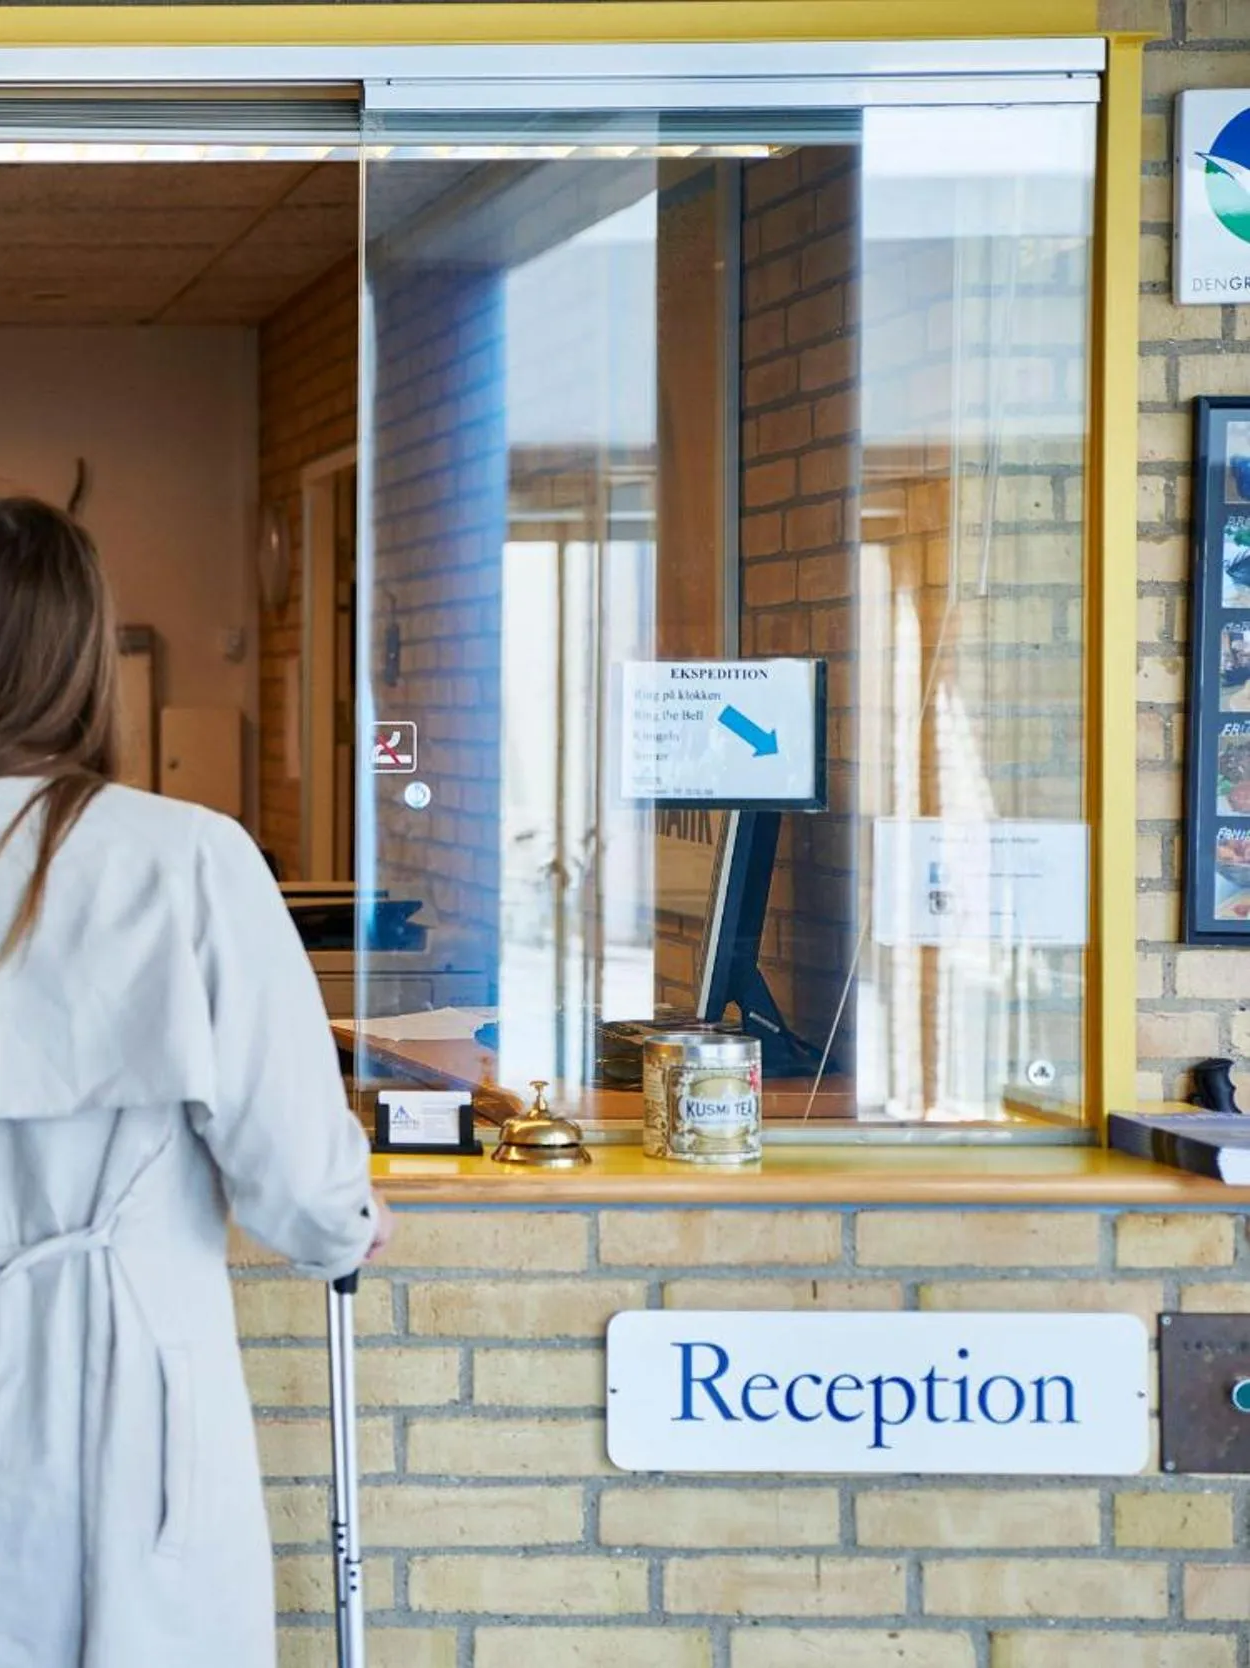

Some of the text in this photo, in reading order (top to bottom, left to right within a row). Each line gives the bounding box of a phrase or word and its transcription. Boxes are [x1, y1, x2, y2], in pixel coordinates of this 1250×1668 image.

[670, 668, 768, 680] EKSPEDITION
[678, 689, 721, 701] klokken
[682, 710, 704, 721] Bell
[685, 1100, 730, 1118] KUSMI
[670, 1342, 1081, 1449] Reception
